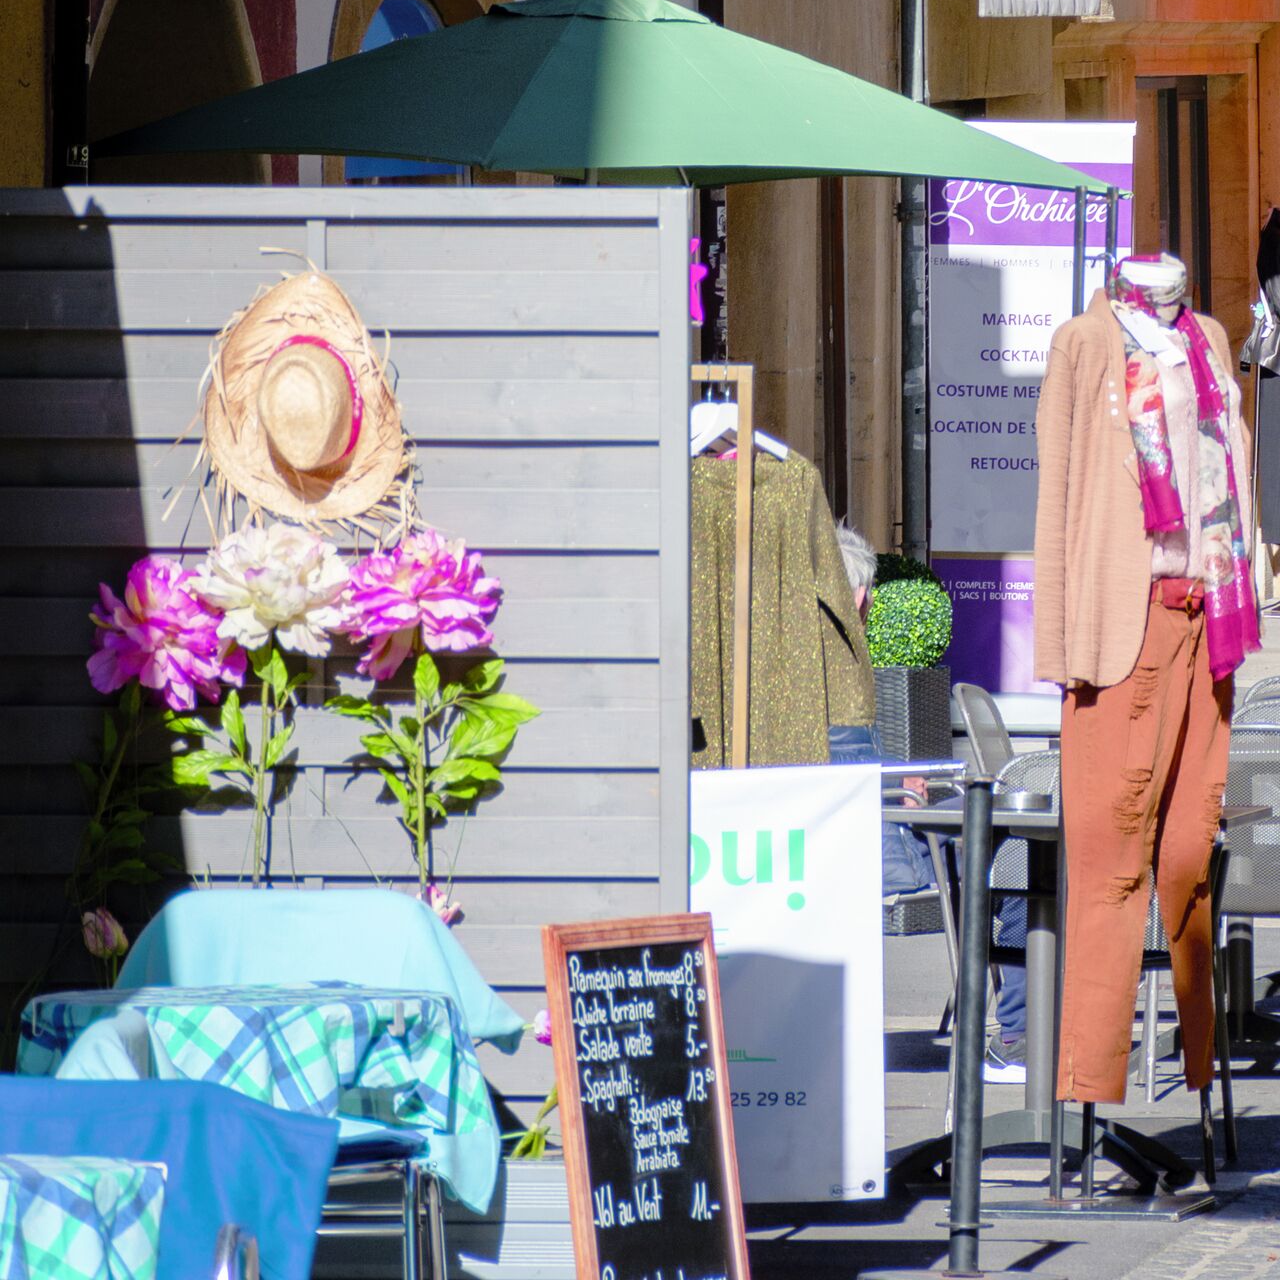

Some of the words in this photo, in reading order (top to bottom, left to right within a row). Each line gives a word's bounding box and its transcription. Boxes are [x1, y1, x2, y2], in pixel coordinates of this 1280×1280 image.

[993, 259, 1040, 268] HOMMES
[982, 313, 1052, 326] MARIAGE
[937, 385, 1008, 397] COSTUME
[1008, 422, 1026, 434] DE
[955, 581, 996, 590] COMPLETS
[959, 592, 980, 600] SACS
[989, 592, 1029, 601] BOUTONS
[642, 948, 685, 998] fromages
[609, 991, 655, 1022] lorraine
[624, 1022, 653, 1056] verte
[730, 1092, 751, 1107] 25
[757, 1092, 779, 1107] 29
[785, 1091, 807, 1106] 82
[629, 1095, 683, 1129] Bolognaise
[633, 1125, 657, 1150] Sauce
[658, 1117, 690, 1146] tomate
[618, 1202, 636, 1226] au
[635, 1178, 662, 1221] Vent
